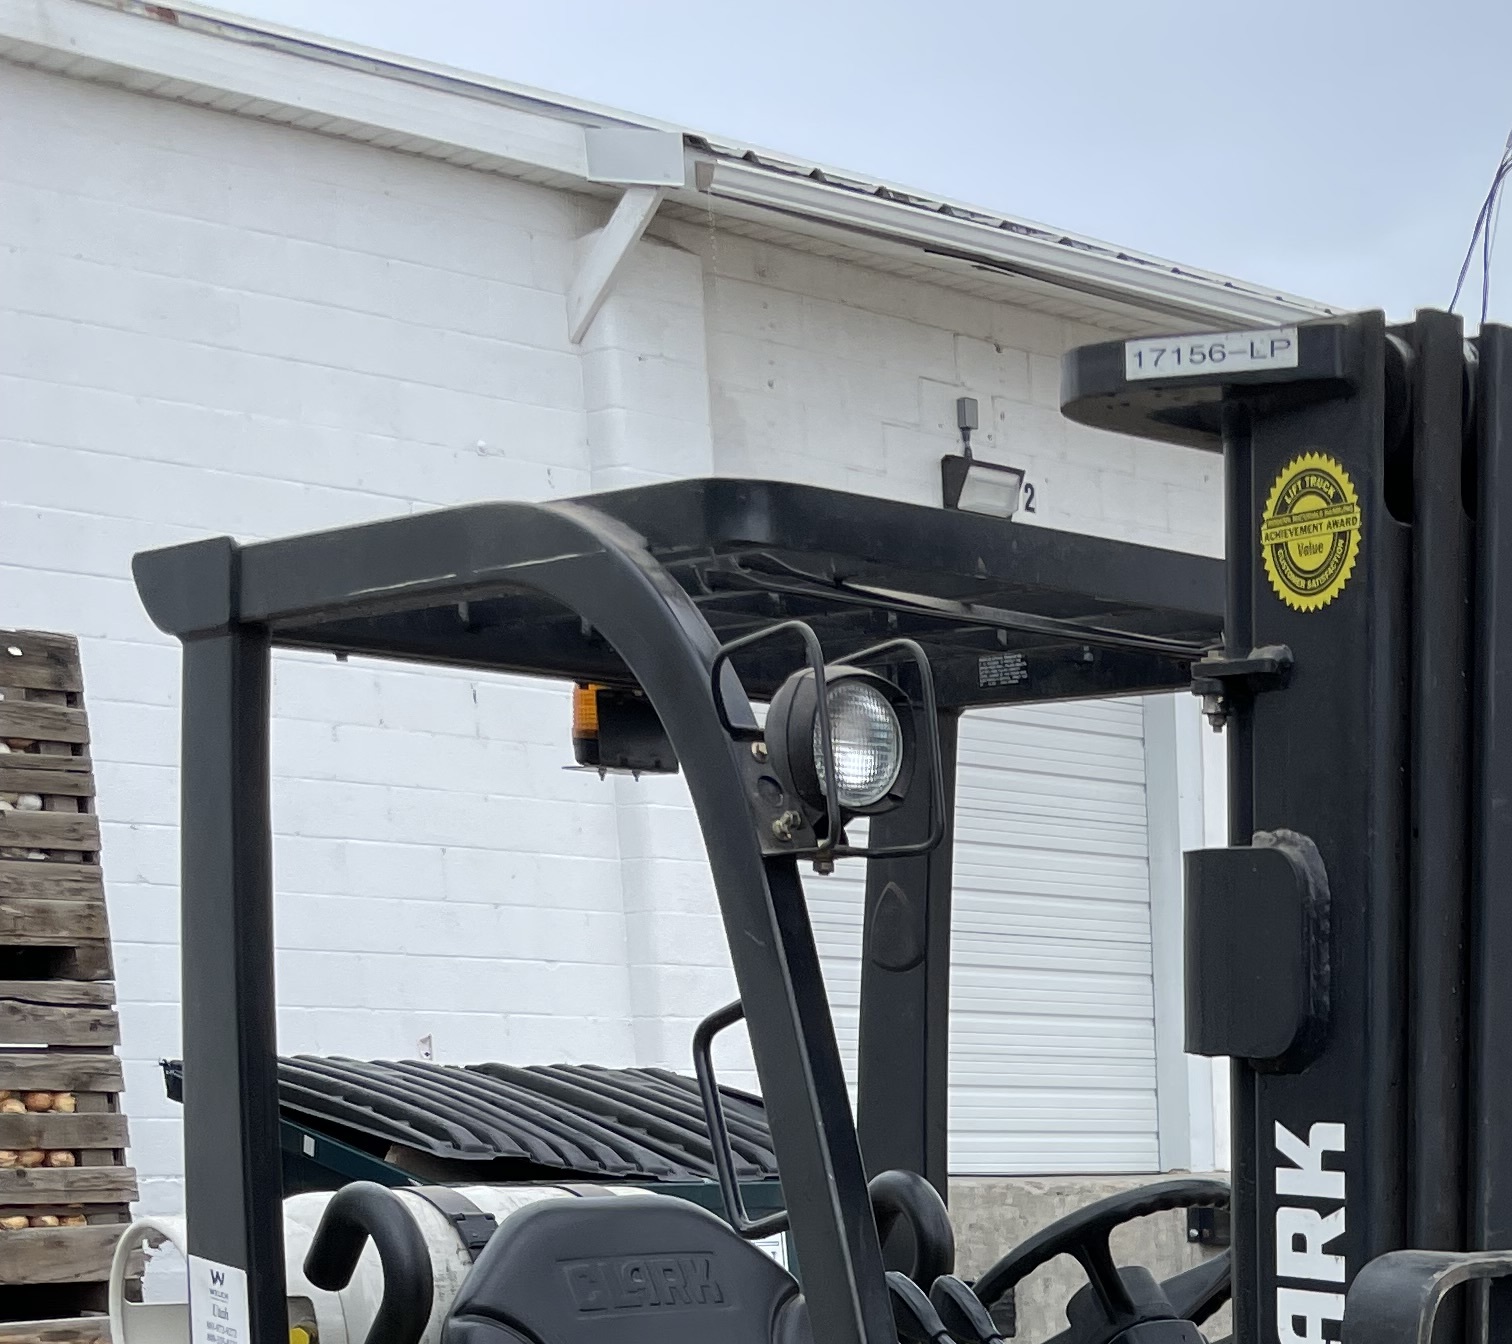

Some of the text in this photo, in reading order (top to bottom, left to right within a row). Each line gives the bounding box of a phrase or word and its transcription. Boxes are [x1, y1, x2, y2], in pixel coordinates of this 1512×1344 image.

[1133, 338, 1292, 369] 17156-LP
[1023, 483, 1036, 514] 2
[1284, 475, 1336, 505] LIFT TRUCK
[1264, 522, 1324, 543] ACHIEVEMENT
[1326, 516, 1358, 531] AWARD
[1277, 539, 1345, 590] CUSTOMER SATISFACTION
[1297, 541, 1324, 558] Value
[209, 1268, 225, 1287] W
[572, 1256, 726, 1312] CLARK
[212, 1303, 229, 1321] Utah
